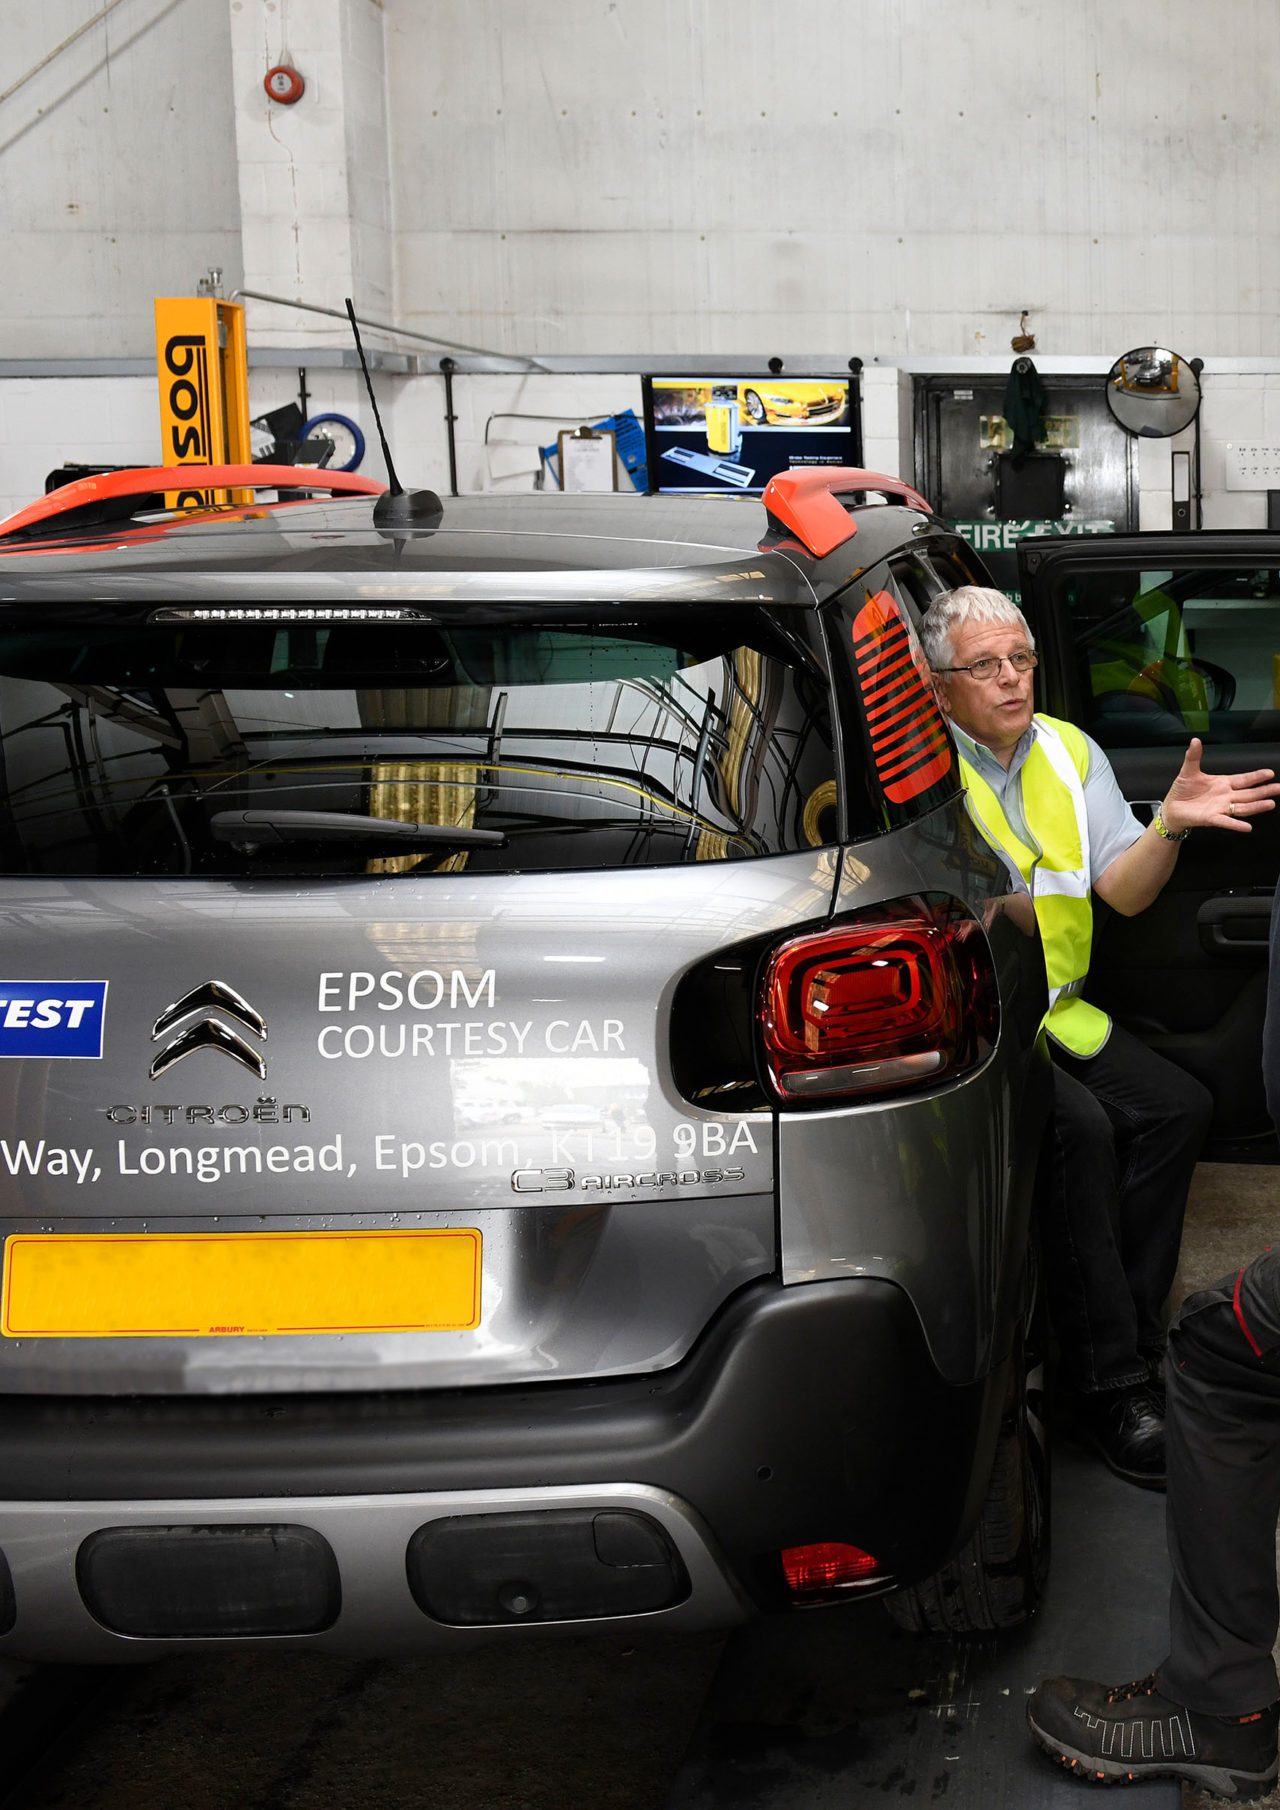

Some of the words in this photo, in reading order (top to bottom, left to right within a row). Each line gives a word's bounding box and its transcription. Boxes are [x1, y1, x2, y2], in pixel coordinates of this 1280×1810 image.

[955, 524, 1019, 549] FIRE
[317, 969, 496, 1012] EPSOM
[317, 1021, 533, 1059] COURTESY
[544, 1019, 626, 1053] CAR
[0, 1139, 101, 1184] Way,
[118, 1134, 357, 1183] Longmead,
[374, 1134, 533, 1178] Epsom,
[552, 1125, 657, 1164] KT19
[672, 1120, 758, 1160] 9BA
[511, 1166, 576, 1193] C3
[581, 1166, 745, 1190] AIRCROSS
